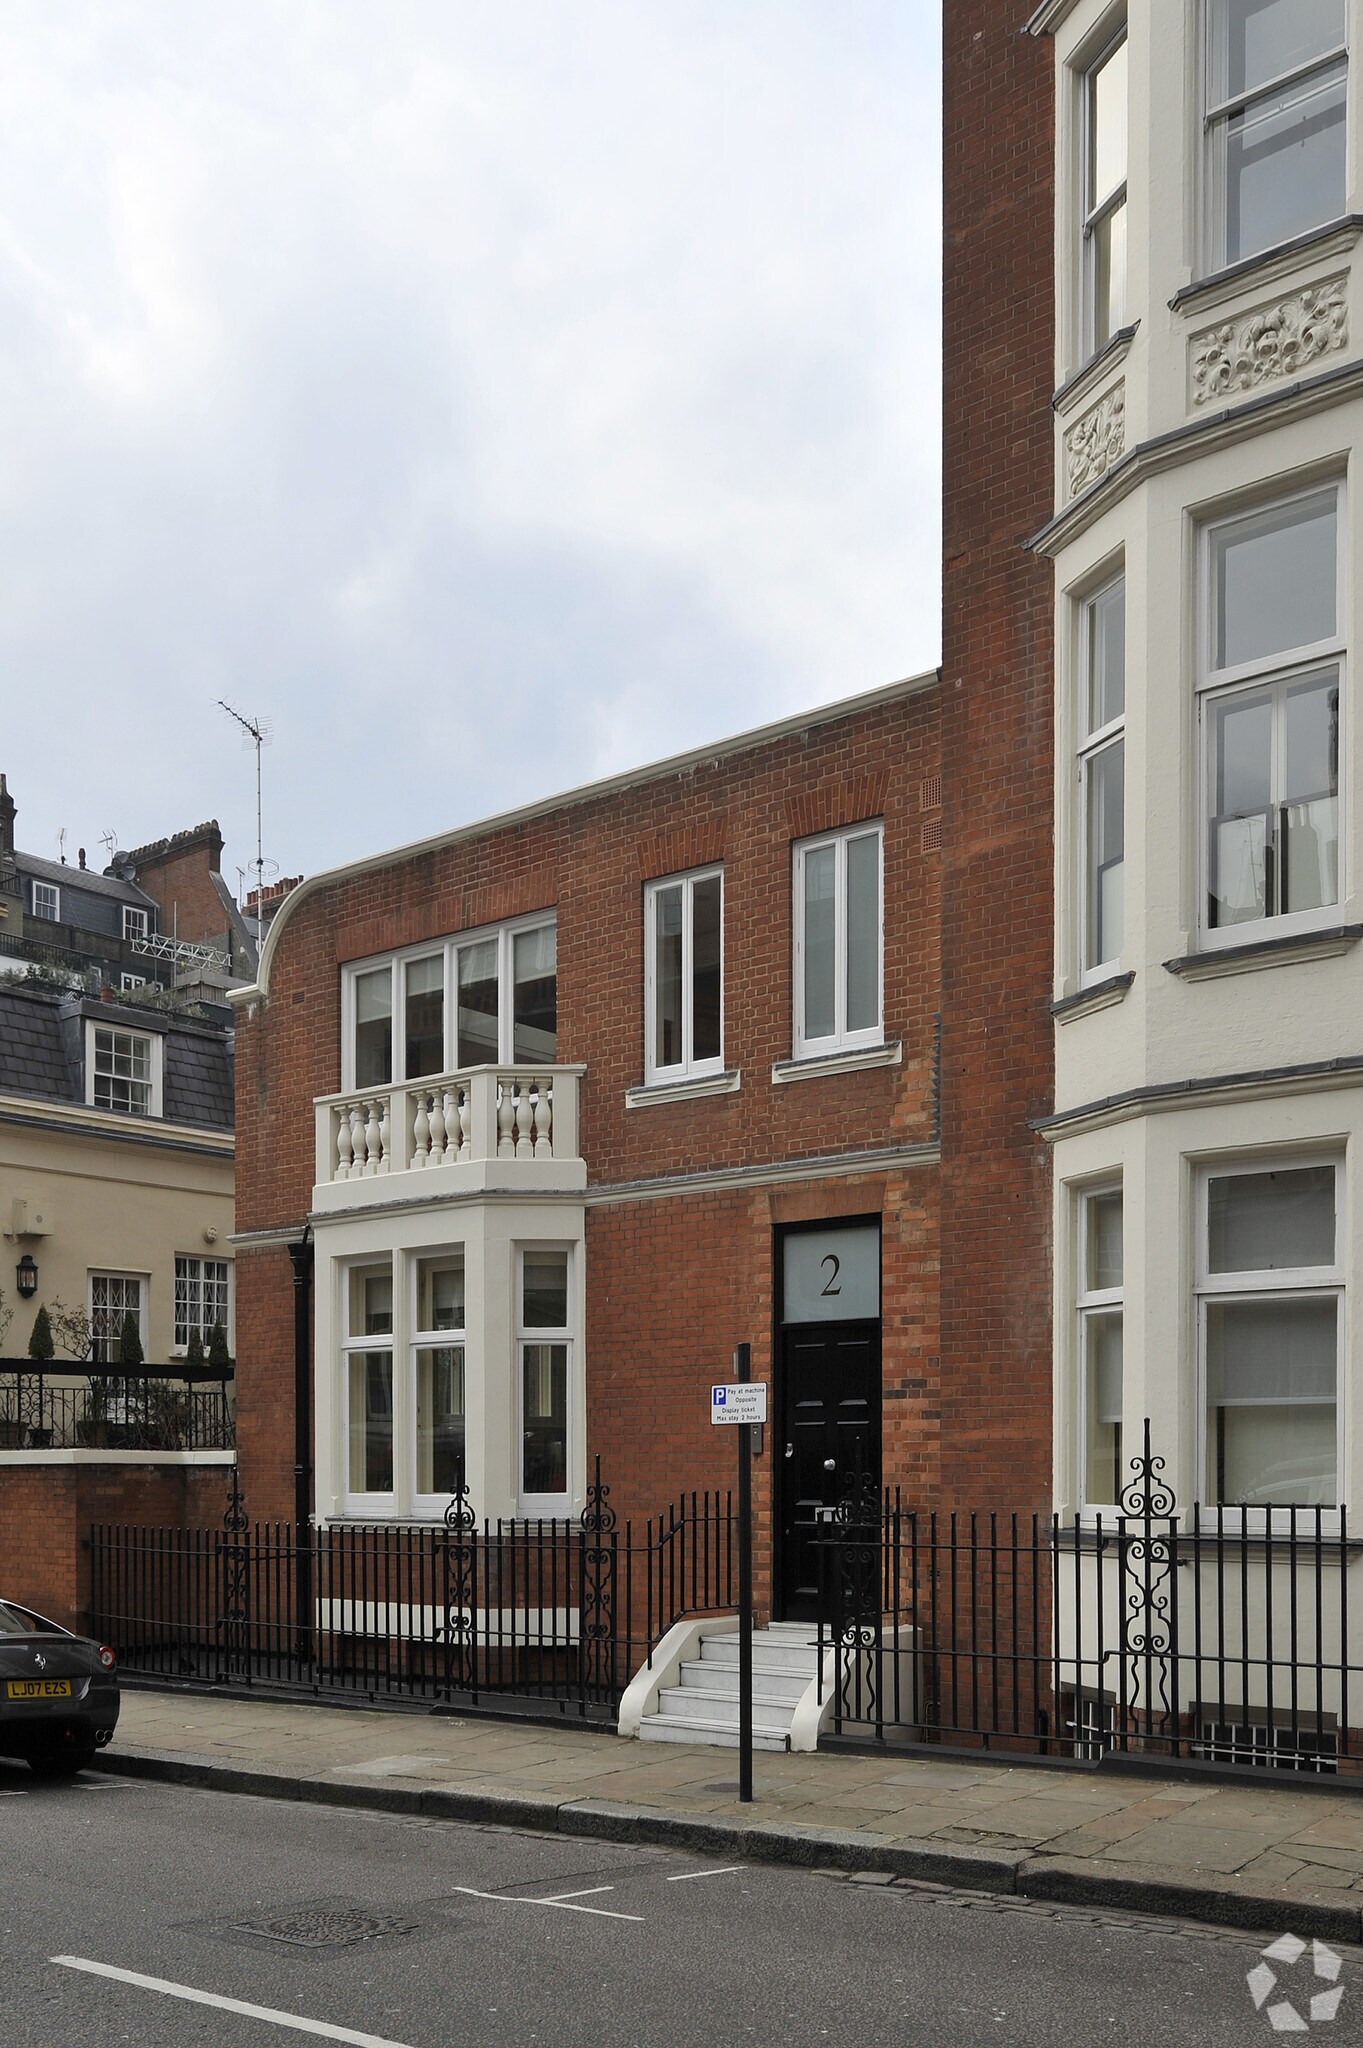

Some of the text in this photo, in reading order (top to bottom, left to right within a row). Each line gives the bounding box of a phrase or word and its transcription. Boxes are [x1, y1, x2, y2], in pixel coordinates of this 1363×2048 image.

[820, 1254, 842, 1296] 2
[716, 1388, 725, 1405] P
[12, 1682, 67, 1696] LJ07 EZS
